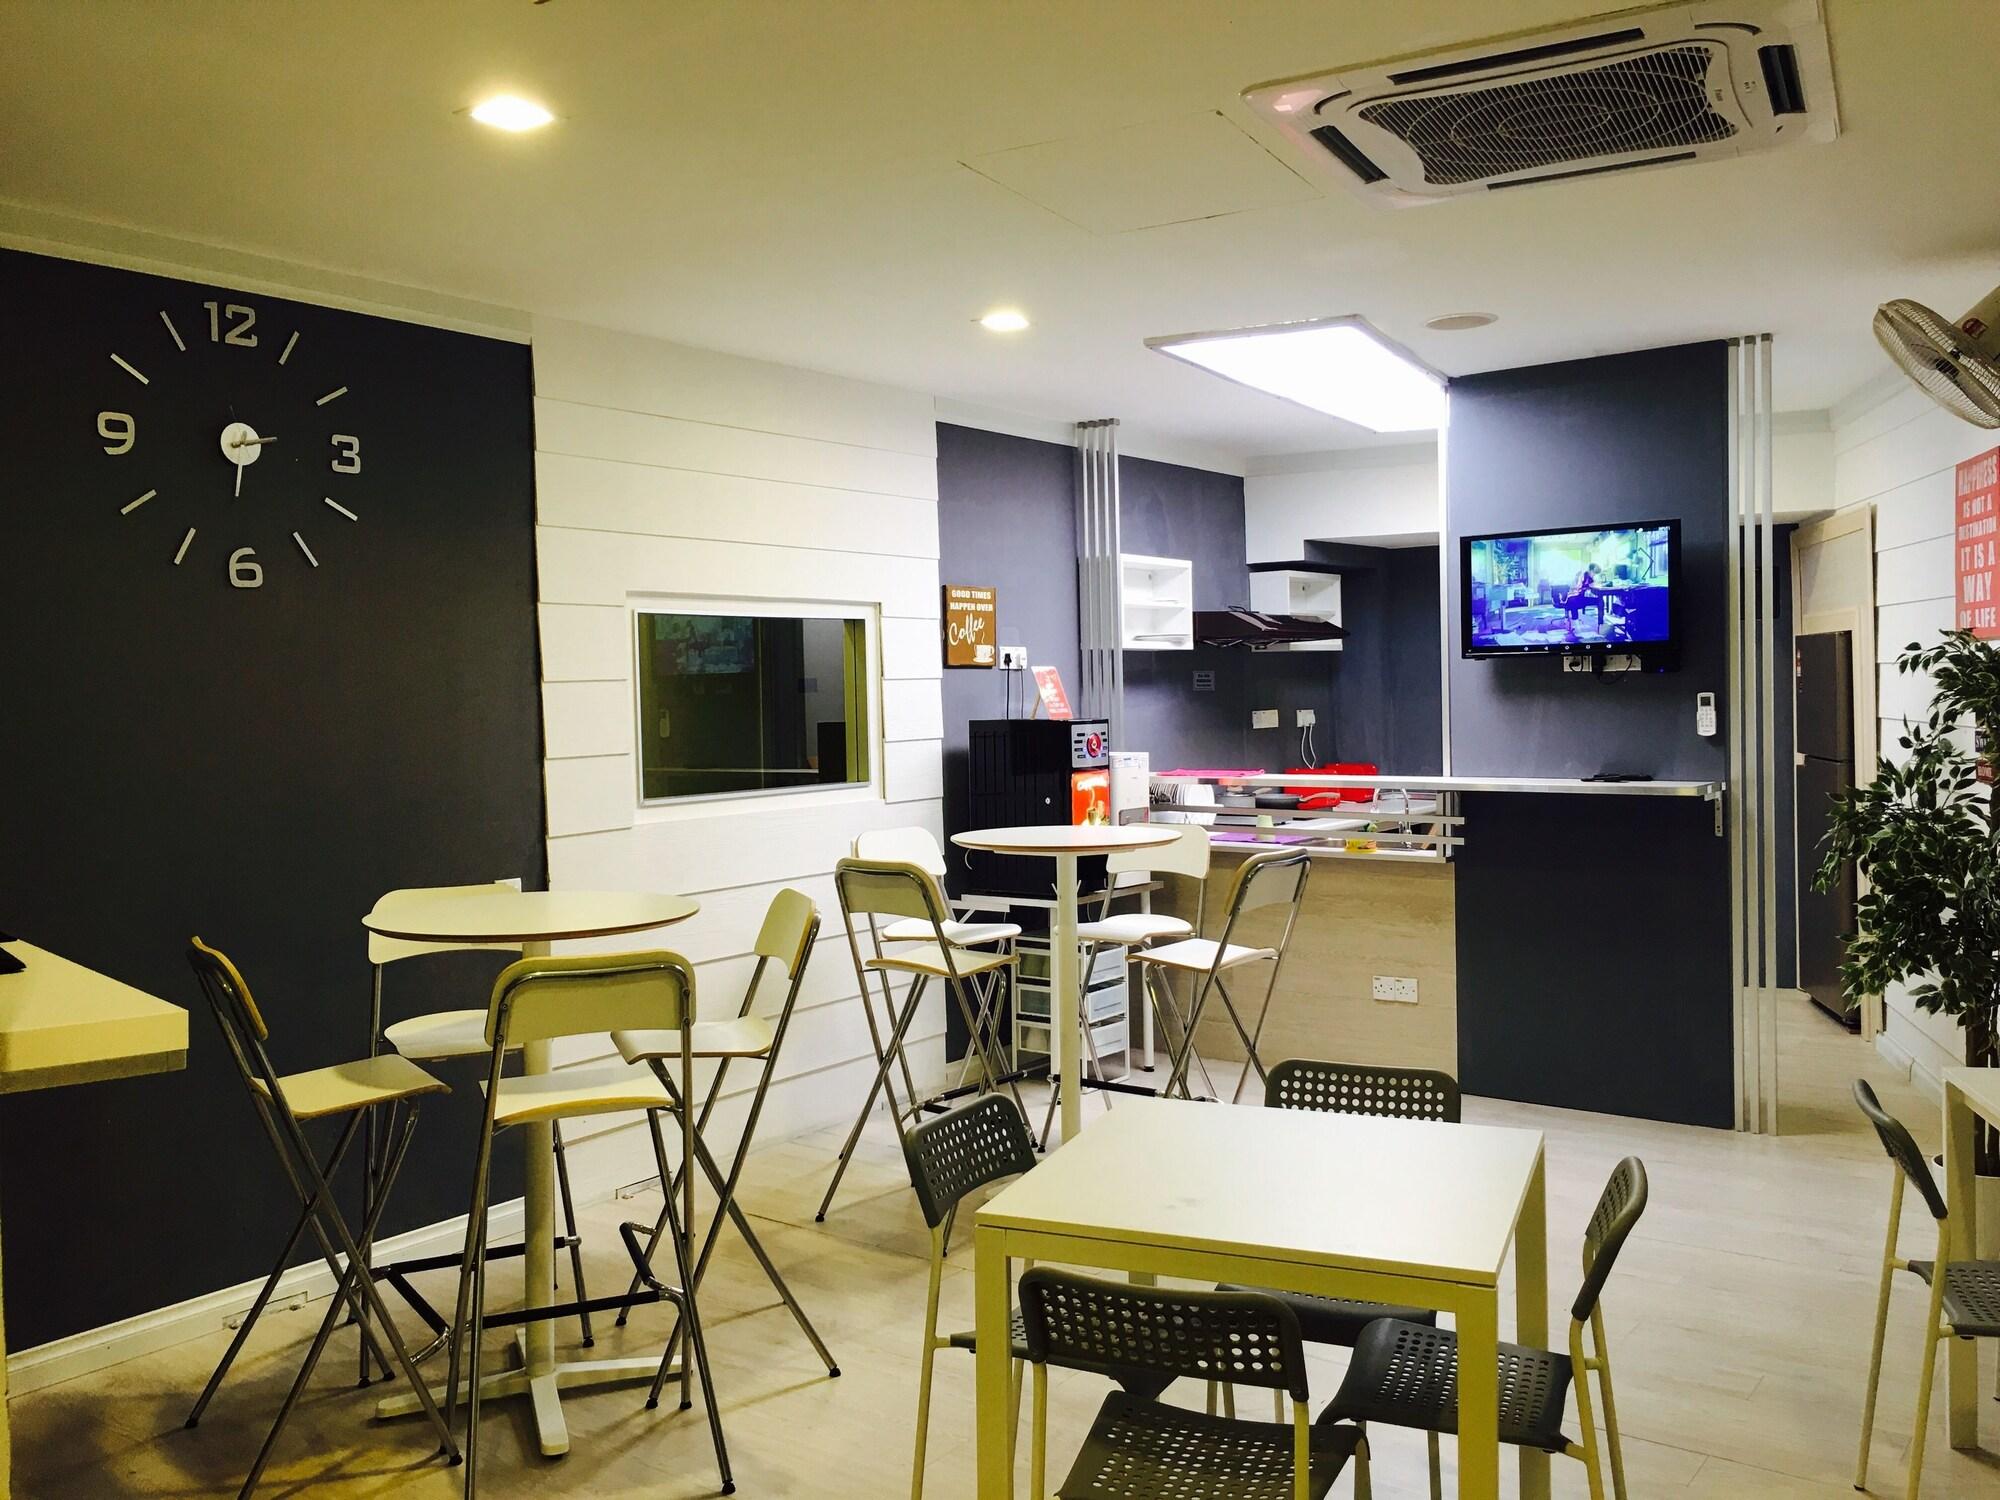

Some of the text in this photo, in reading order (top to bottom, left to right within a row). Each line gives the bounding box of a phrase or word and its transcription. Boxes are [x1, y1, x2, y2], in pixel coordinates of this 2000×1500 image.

[204, 301, 258, 347] 12
[97, 411, 136, 455] 9
[331, 434, 361, 474] 3
[1959, 455, 1997, 496] HAPPINESS
[1963, 493, 1992, 518] IS NOT A
[228, 547, 264, 588] 6
[1960, 540, 1996, 571] IT IS A
[951, 589, 992, 600] GOOD TIMES
[1963, 571, 1992, 603] WAY
[950, 602, 993, 612] HAPPEN OVER
[1960, 607, 1996, 628] OF LIFE
[948, 612, 985, 646] Coffee
